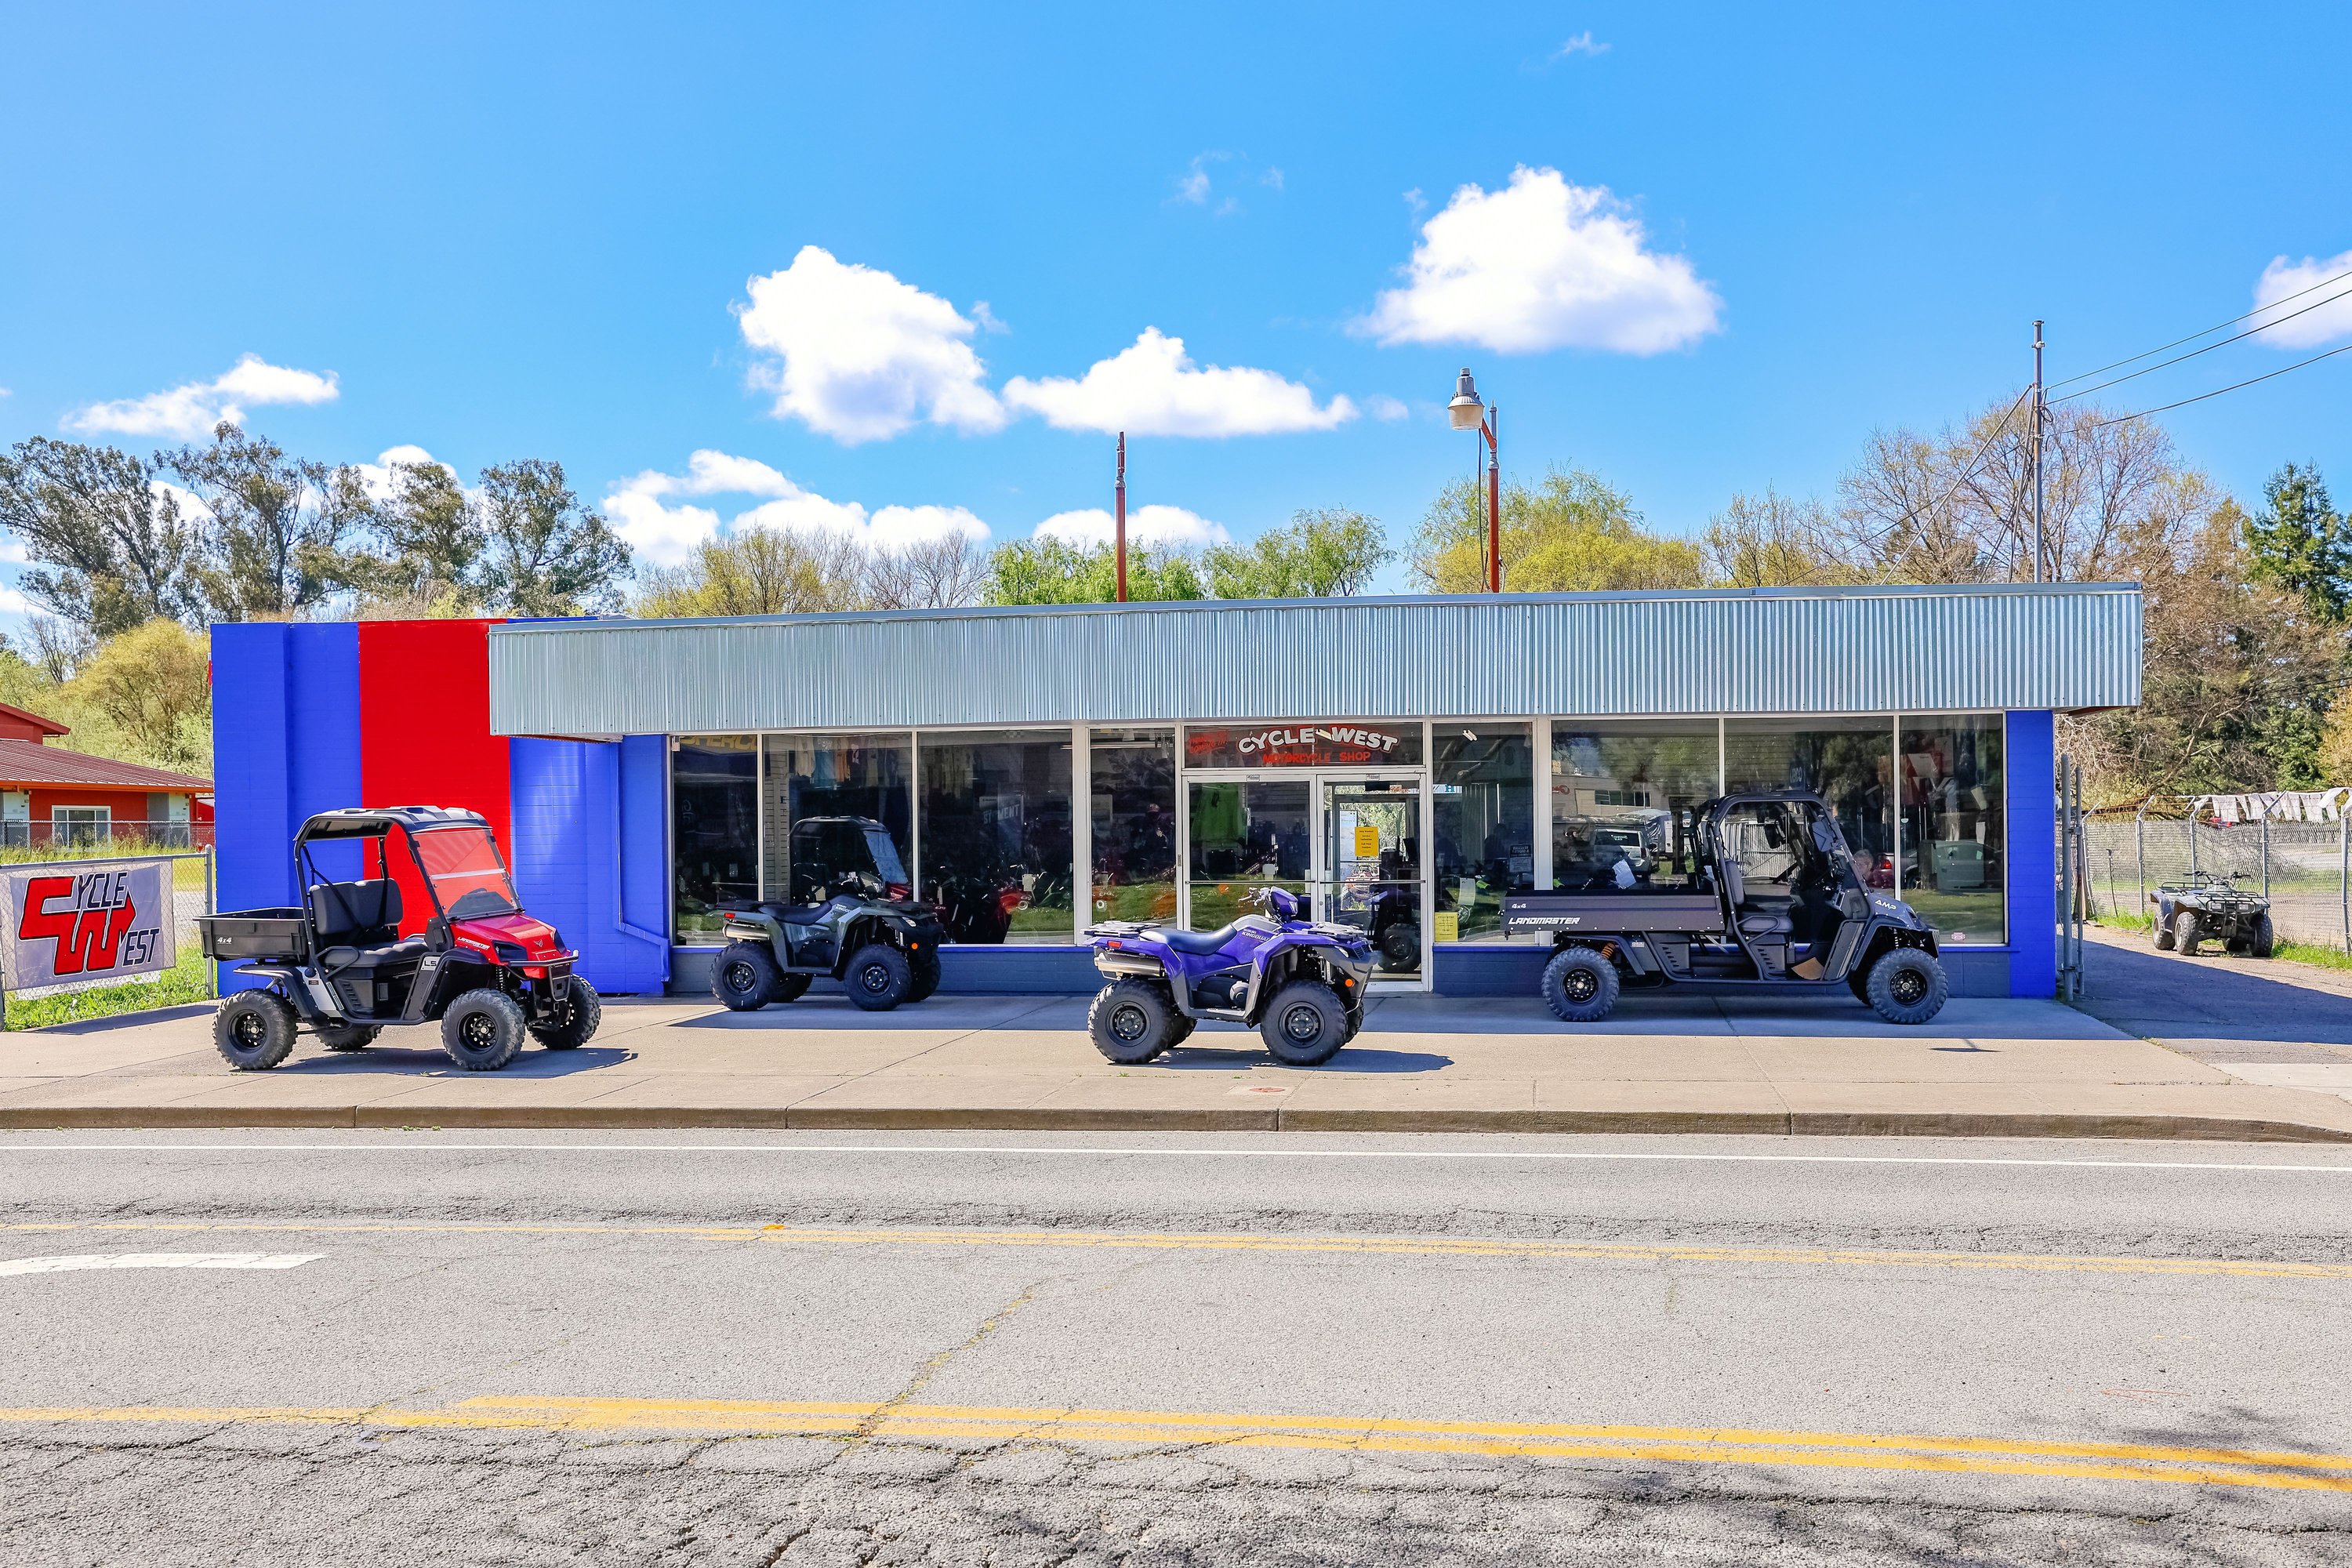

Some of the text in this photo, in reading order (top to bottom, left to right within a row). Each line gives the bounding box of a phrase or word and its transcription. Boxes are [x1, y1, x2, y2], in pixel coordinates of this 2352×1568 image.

[1239, 728, 1315, 753] CYCLE
[1331, 726, 1398, 751] WEST
[1263, 752, 1370, 763] MOTORCYCLE SHOP
[1875, 899, 1896, 910] AMP
